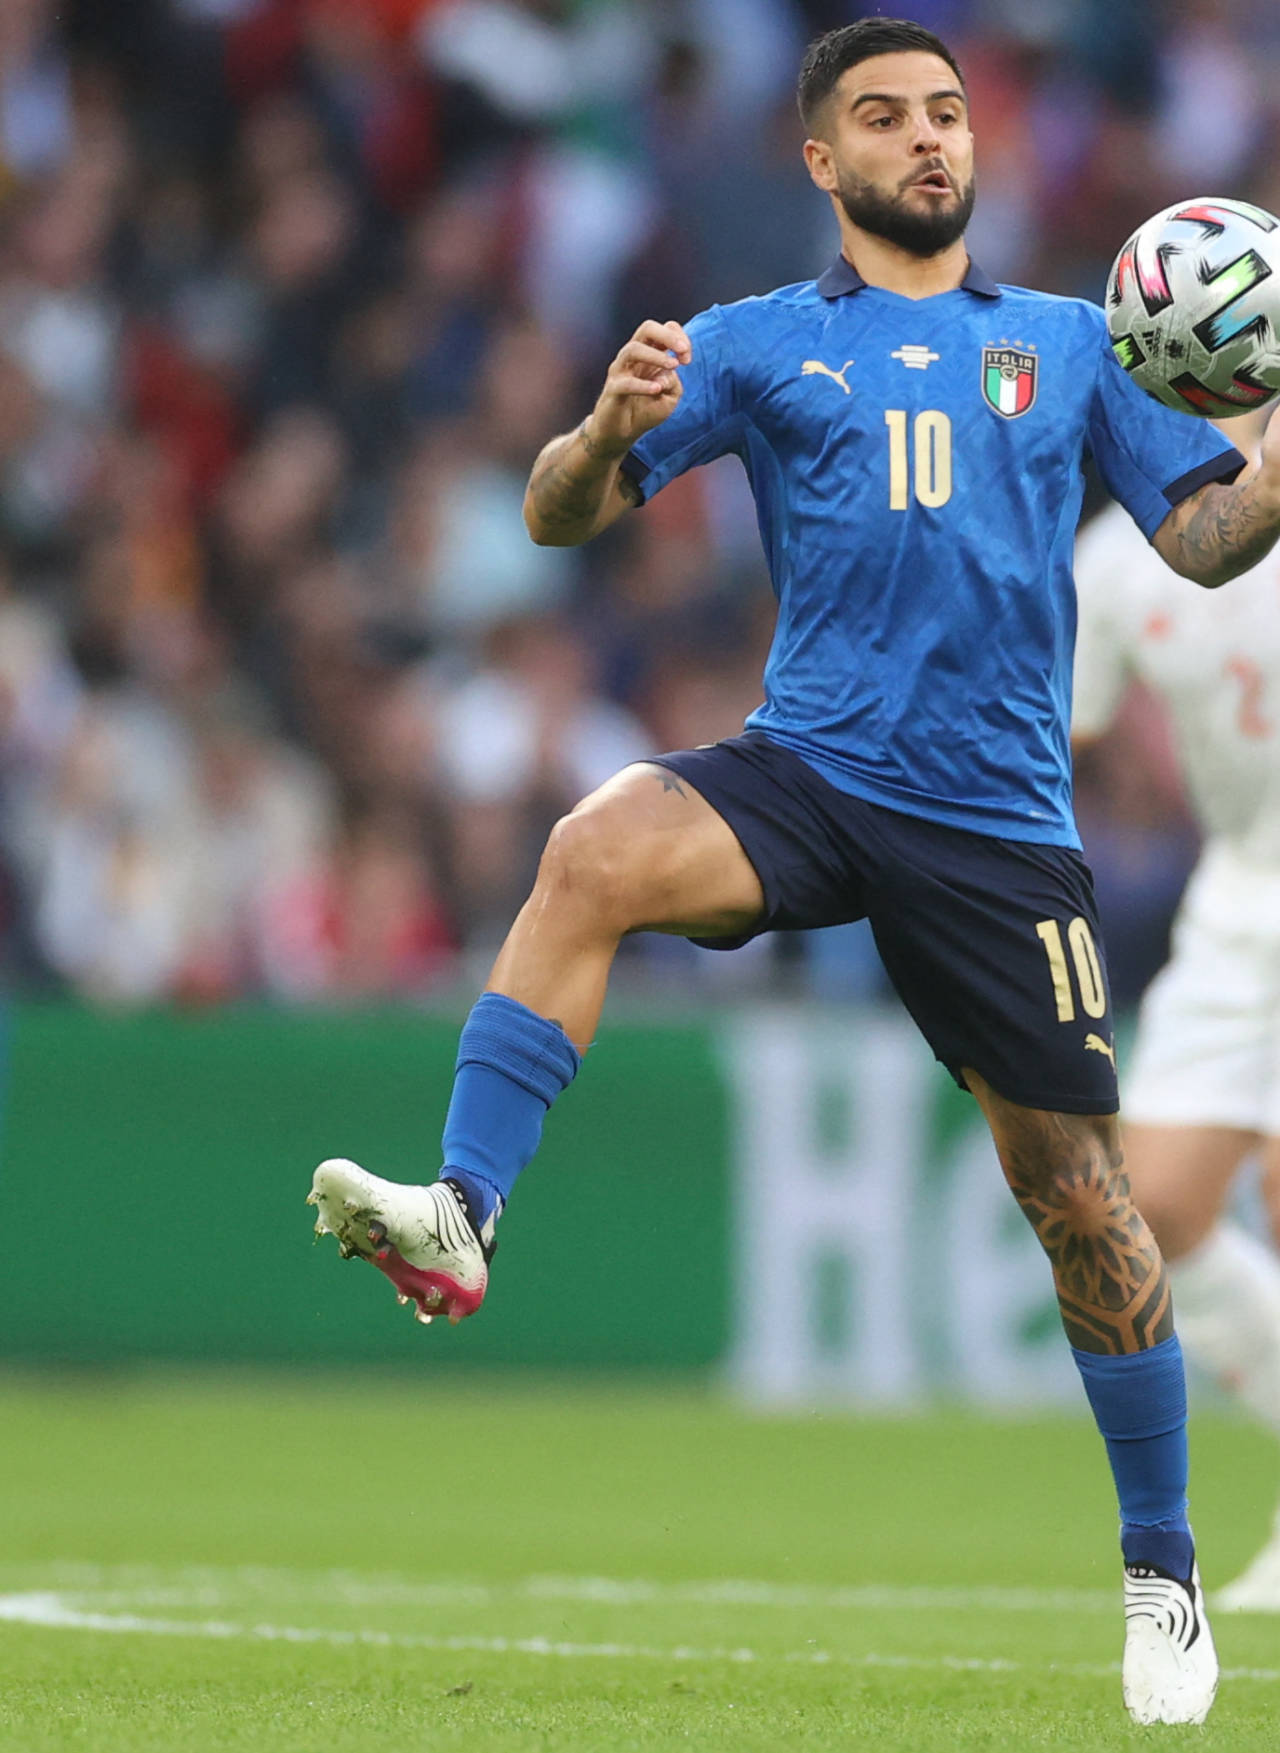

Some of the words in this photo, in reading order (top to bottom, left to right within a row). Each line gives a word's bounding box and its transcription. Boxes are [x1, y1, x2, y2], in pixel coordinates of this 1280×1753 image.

[986, 352, 1033, 369] ITALIA
[884, 409, 952, 511] 10
[1035, 916, 1106, 1023] 10
